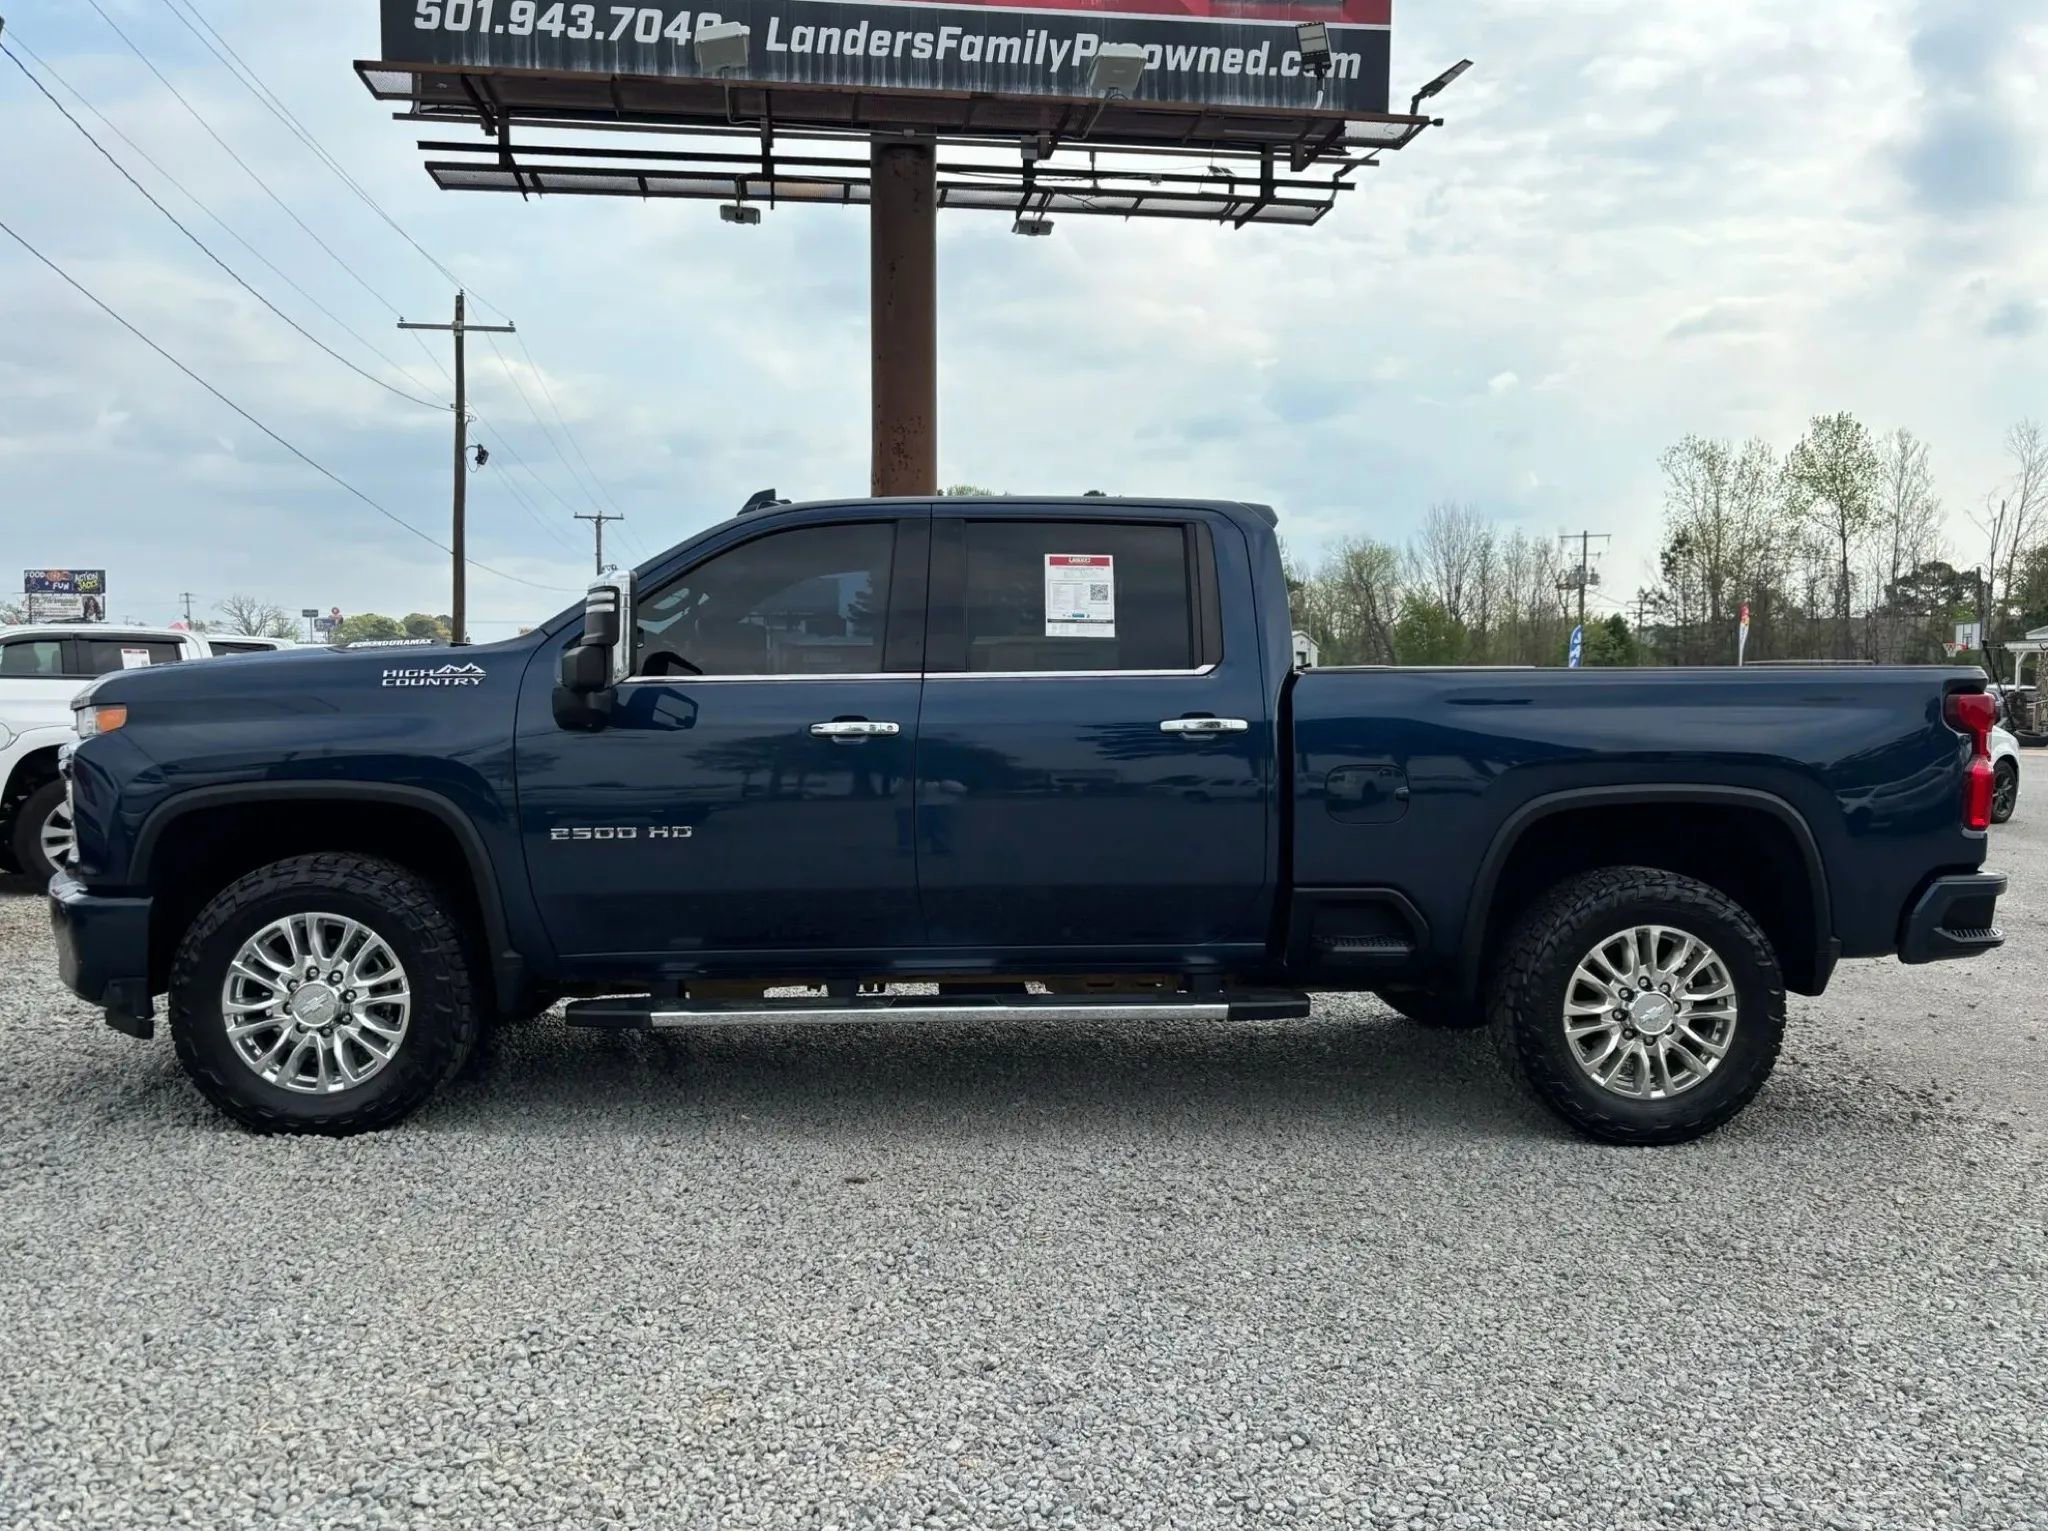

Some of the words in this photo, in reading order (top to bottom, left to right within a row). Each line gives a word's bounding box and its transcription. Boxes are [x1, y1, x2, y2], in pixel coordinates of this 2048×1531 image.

[766, 17, 1361, 79] LandersFamilyPowned.cm
[53, 582, 70, 590] FUN
[383, 669, 434, 678] HIGH
[382, 677, 484, 687] COUNTRY
[550, 827, 638, 840] 2500
[649, 826, 693, 838] HD
